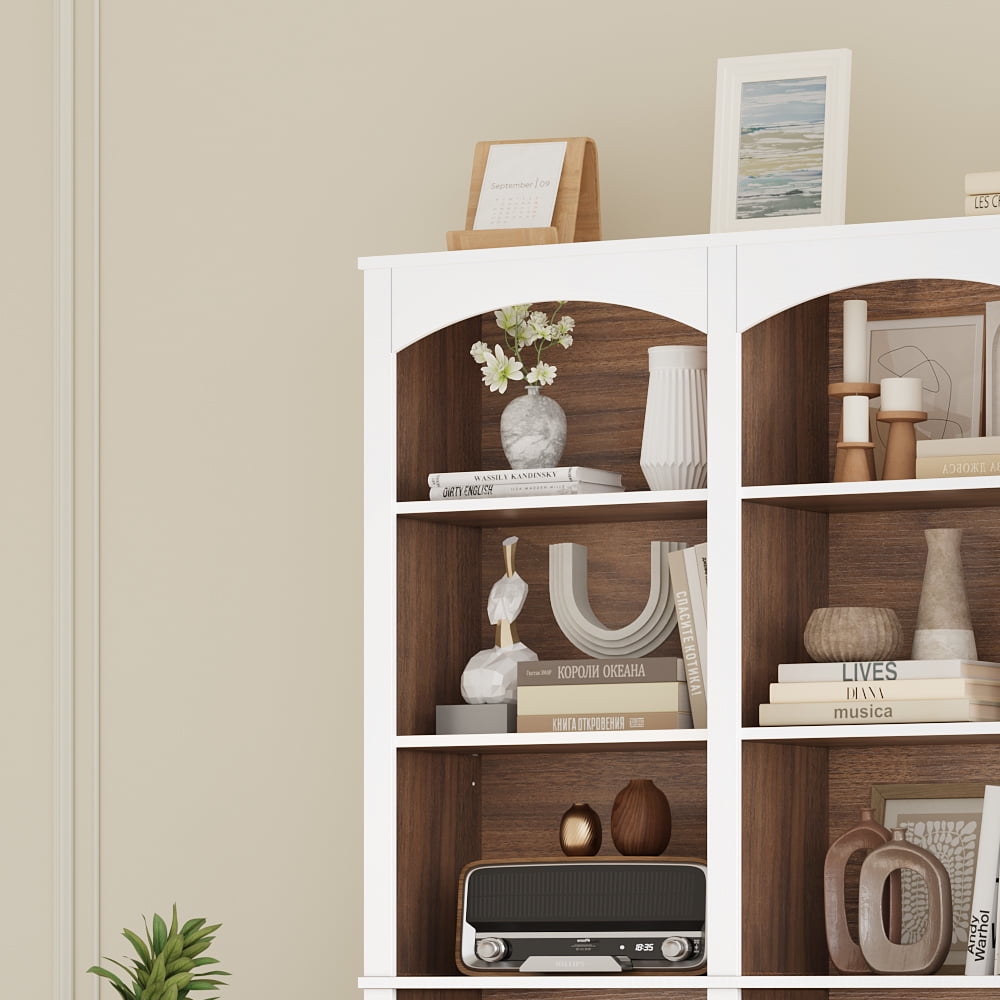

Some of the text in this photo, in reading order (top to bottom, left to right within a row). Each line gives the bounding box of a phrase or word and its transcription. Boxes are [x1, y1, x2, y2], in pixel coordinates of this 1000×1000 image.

[974, 195, 989, 209] LES
[474, 474, 508, 482] WASSILY
[511, 471, 557, 480] KANDINSKY
[443, 485, 494, 497] DIRTY ENGLISH
[675, 591, 702, 696] СПАСИТЕ КОТИКА!
[557, 665, 600, 679] КОРОЛИ
[603, 664, 646, 678] ОКЕАНА
[842, 661, 898, 682] LIVES
[834, 703, 893, 719] musica
[552, 718, 576, 732] КНИГА
[578, 717, 624, 731] ОТКРОВЕНИЯ
[975, 910, 990, 962] Warhol
